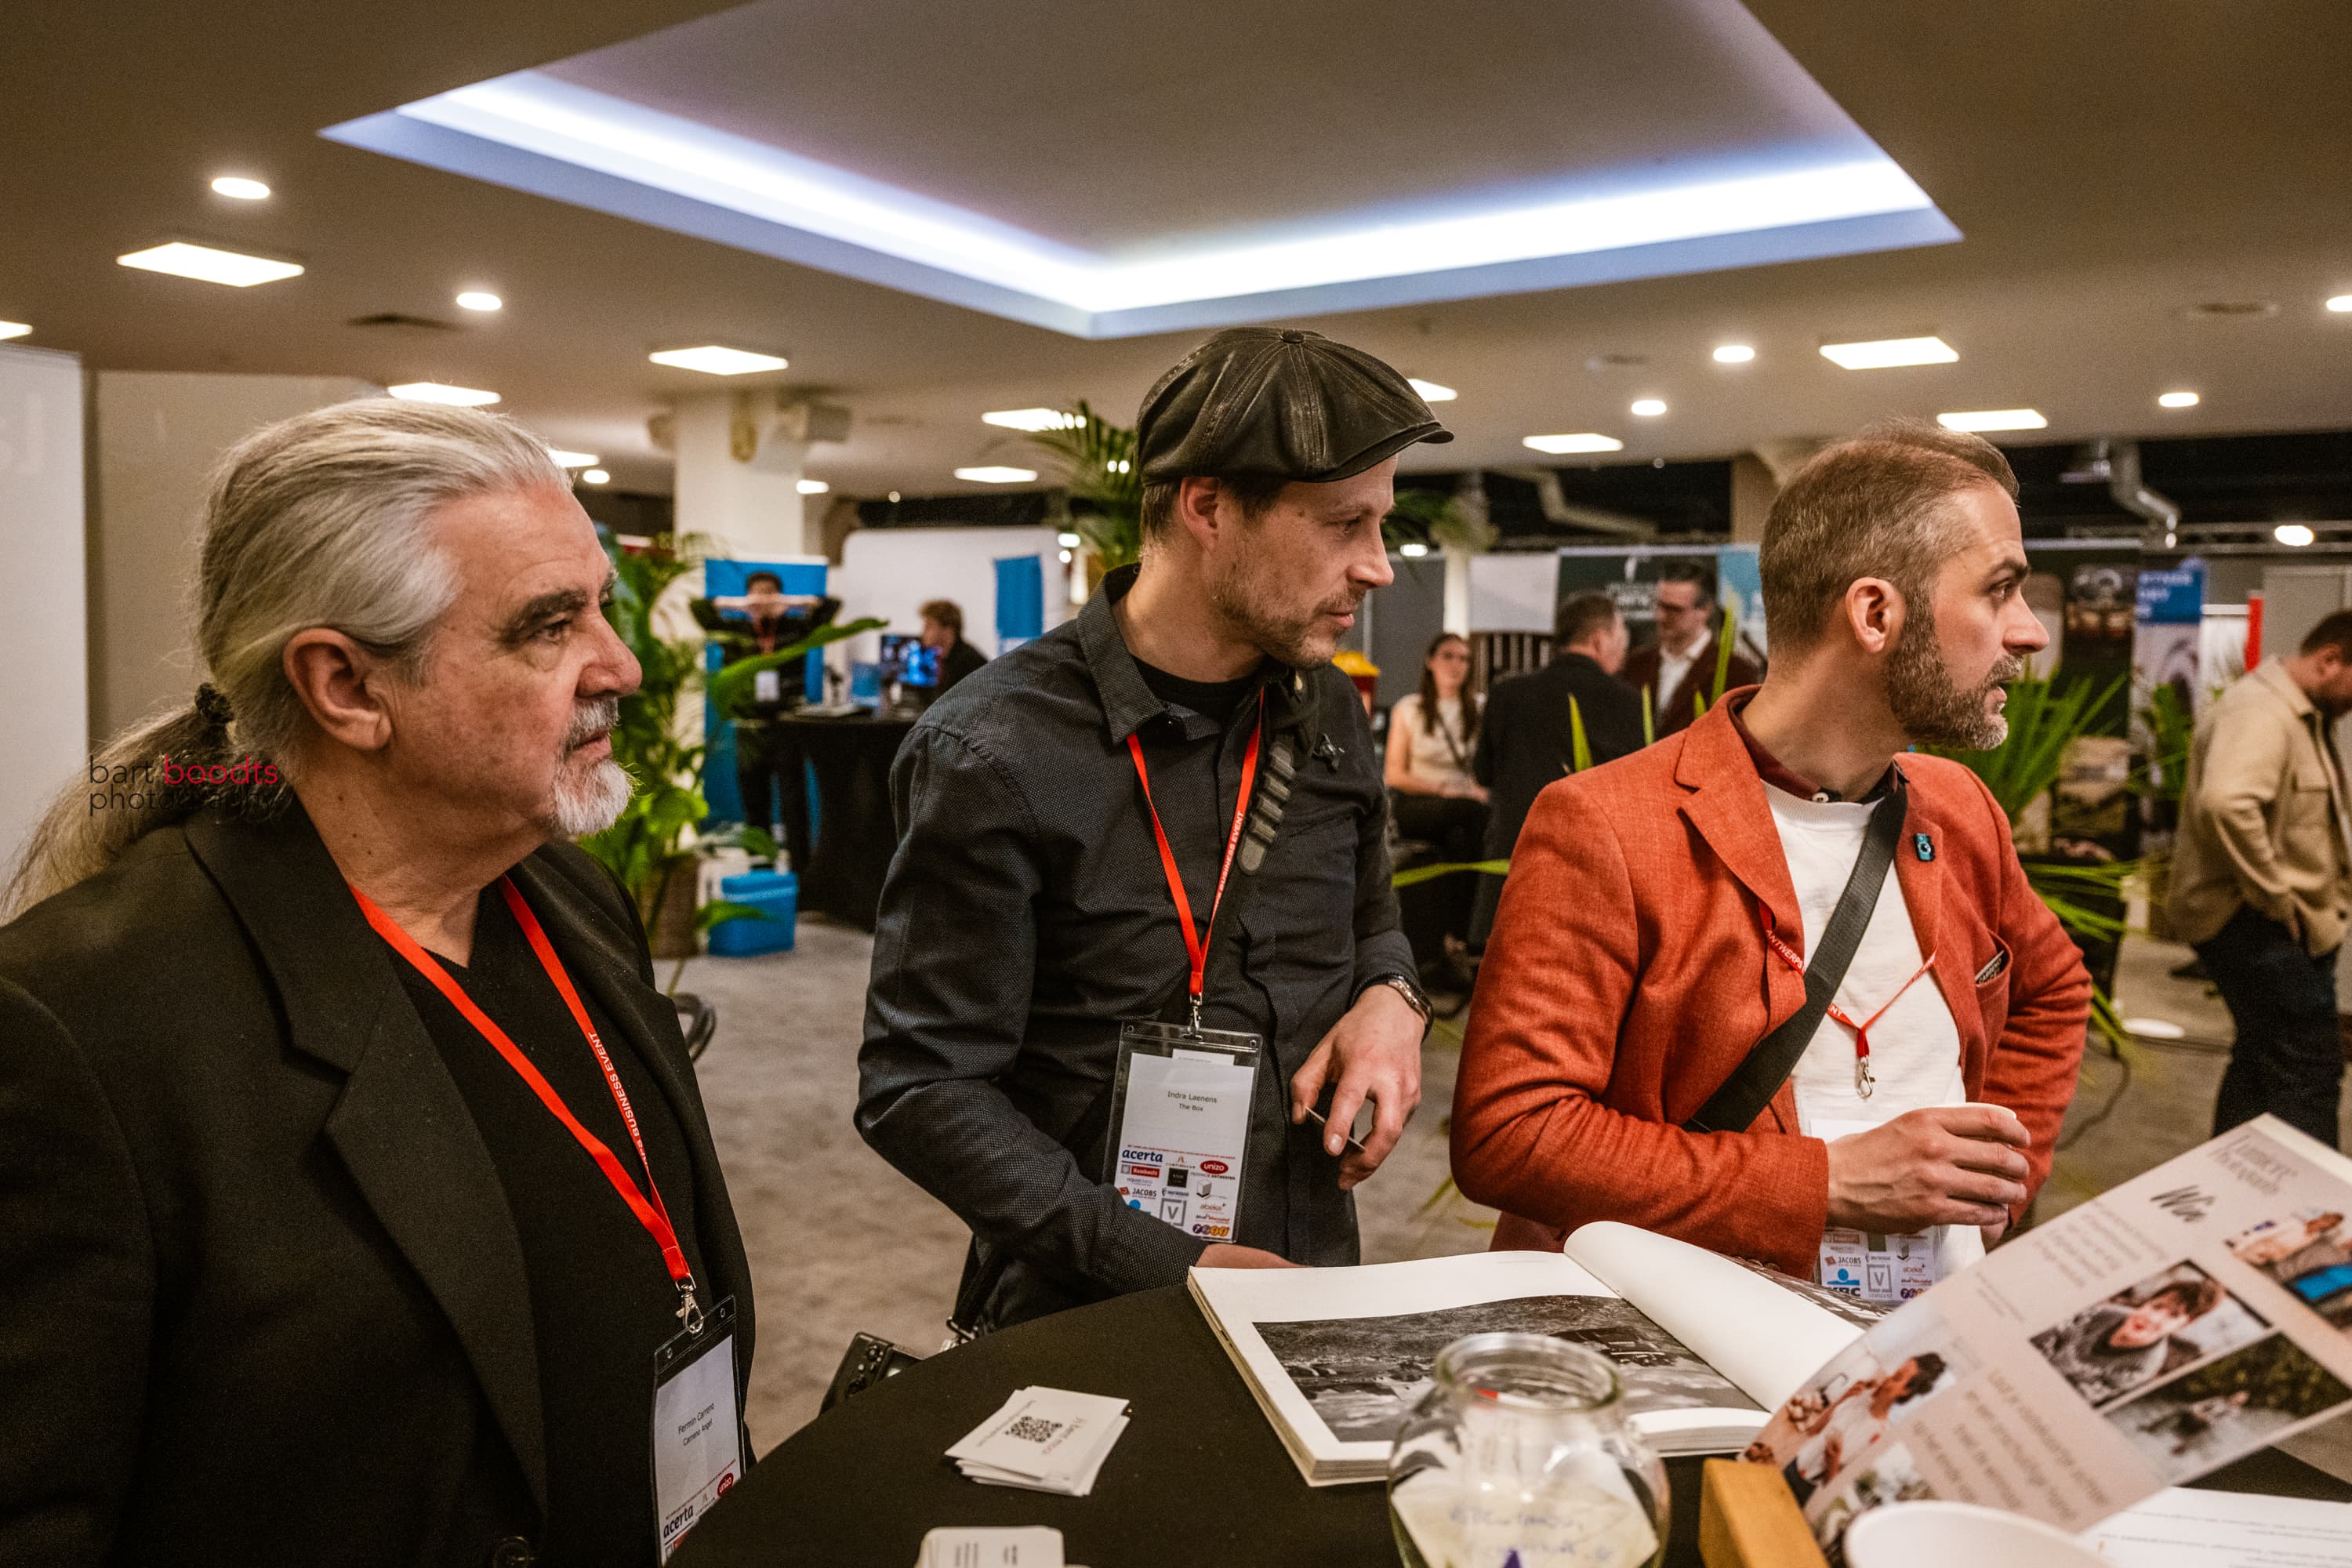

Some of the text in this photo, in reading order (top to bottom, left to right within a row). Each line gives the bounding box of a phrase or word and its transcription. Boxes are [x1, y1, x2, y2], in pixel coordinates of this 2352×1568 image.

[1219, 811, 1244, 892] BUSINESS EVENT
[1766, 929, 1803, 970] ANTWERPS
[588, 1032, 640, 1137] BUSINESS EVENT
[1167, 1091, 1217, 1103] Indra Laenens
[1122, 1149, 1163, 1163] acerta
[1203, 1163, 1225, 1171] unizo
[1132, 1188, 1157, 1197] JACOBS
[1167, 1206, 1179, 1220] V
[1874, 1272, 1885, 1286] V
[1831, 1287, 1861, 1297] BC
[678, 1417, 696, 1435] Fermin
[719, 1475, 733, 1494] unizo
[663, 1504, 694, 1538] acerta
